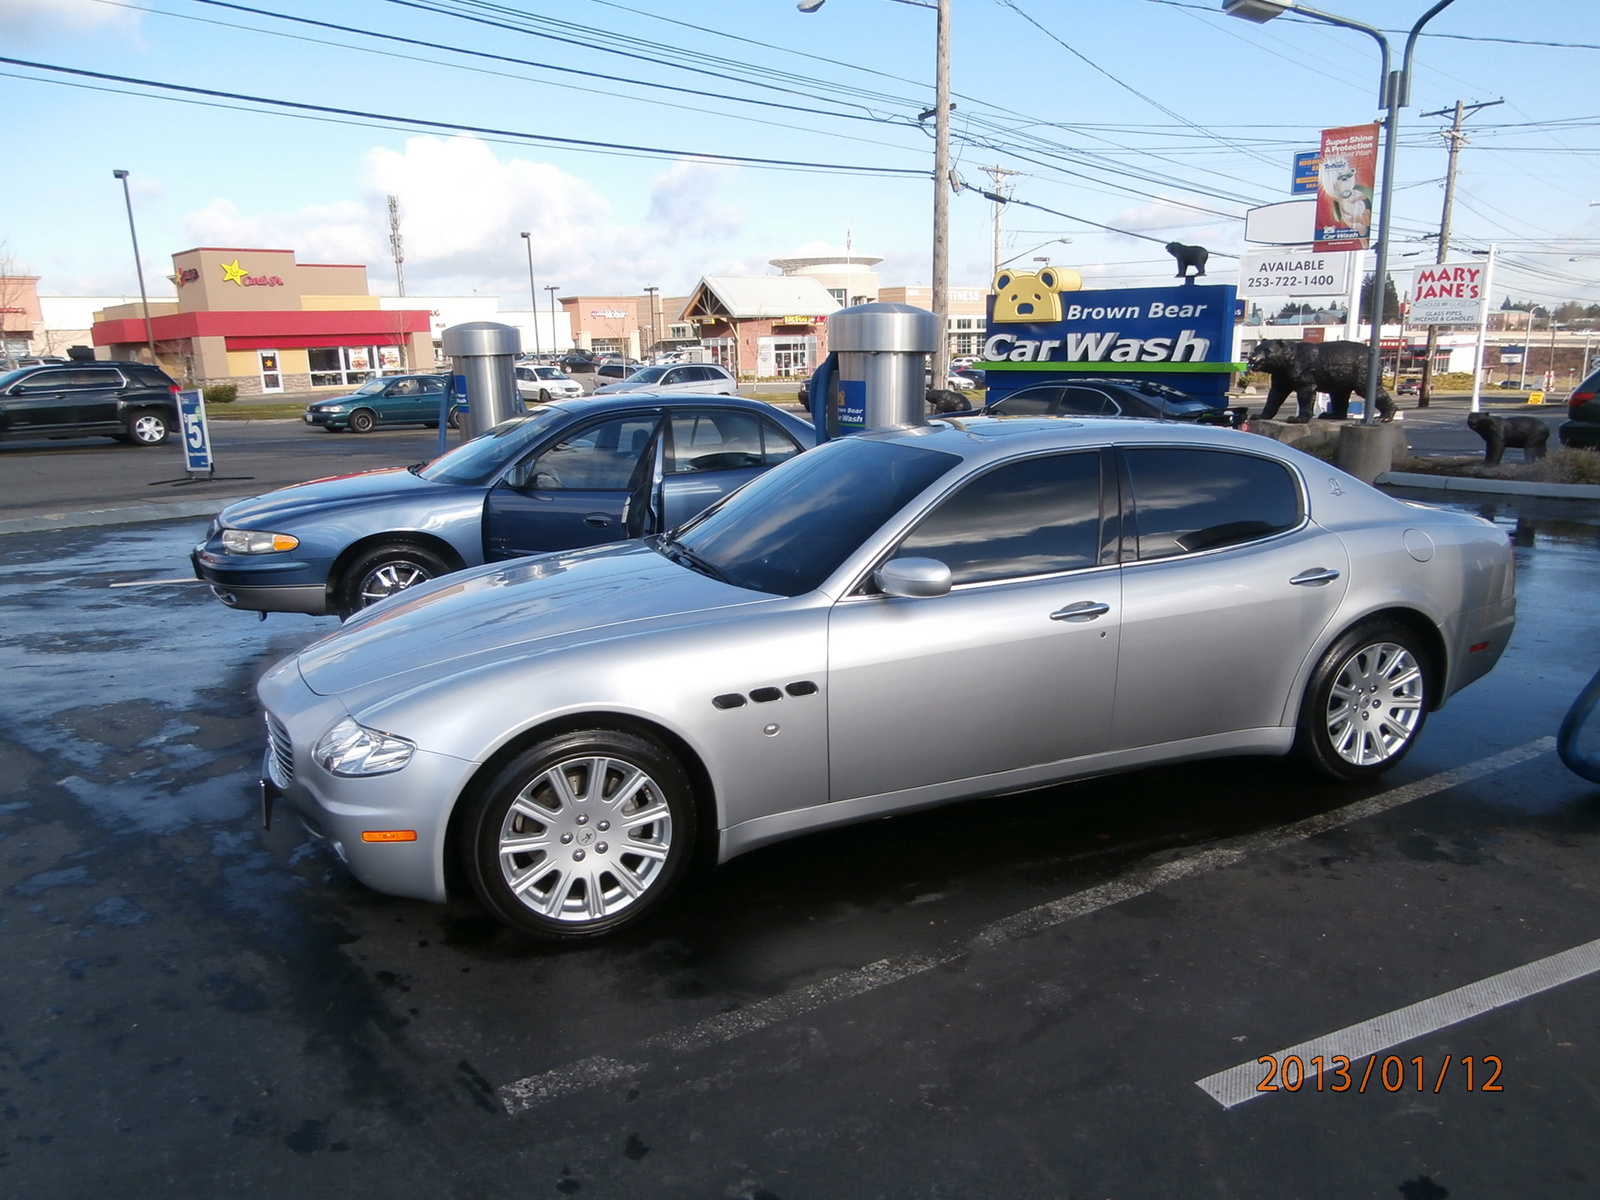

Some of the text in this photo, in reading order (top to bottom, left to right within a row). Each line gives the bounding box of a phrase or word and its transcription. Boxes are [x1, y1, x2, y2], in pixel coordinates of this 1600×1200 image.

[1325, 135, 1374, 147] Super Shine
[1331, 142, 1373, 152] Protection
[1259, 260, 1325, 273] AVAILABLE
[1247, 275, 1334, 288] 253-722-1400
[1417, 267, 1480, 284] MARY
[1415, 283, 1479, 302] JANE'S
[1067, 302, 1207, 321] Brown Bear
[984, 330, 1211, 363] Car Wash
